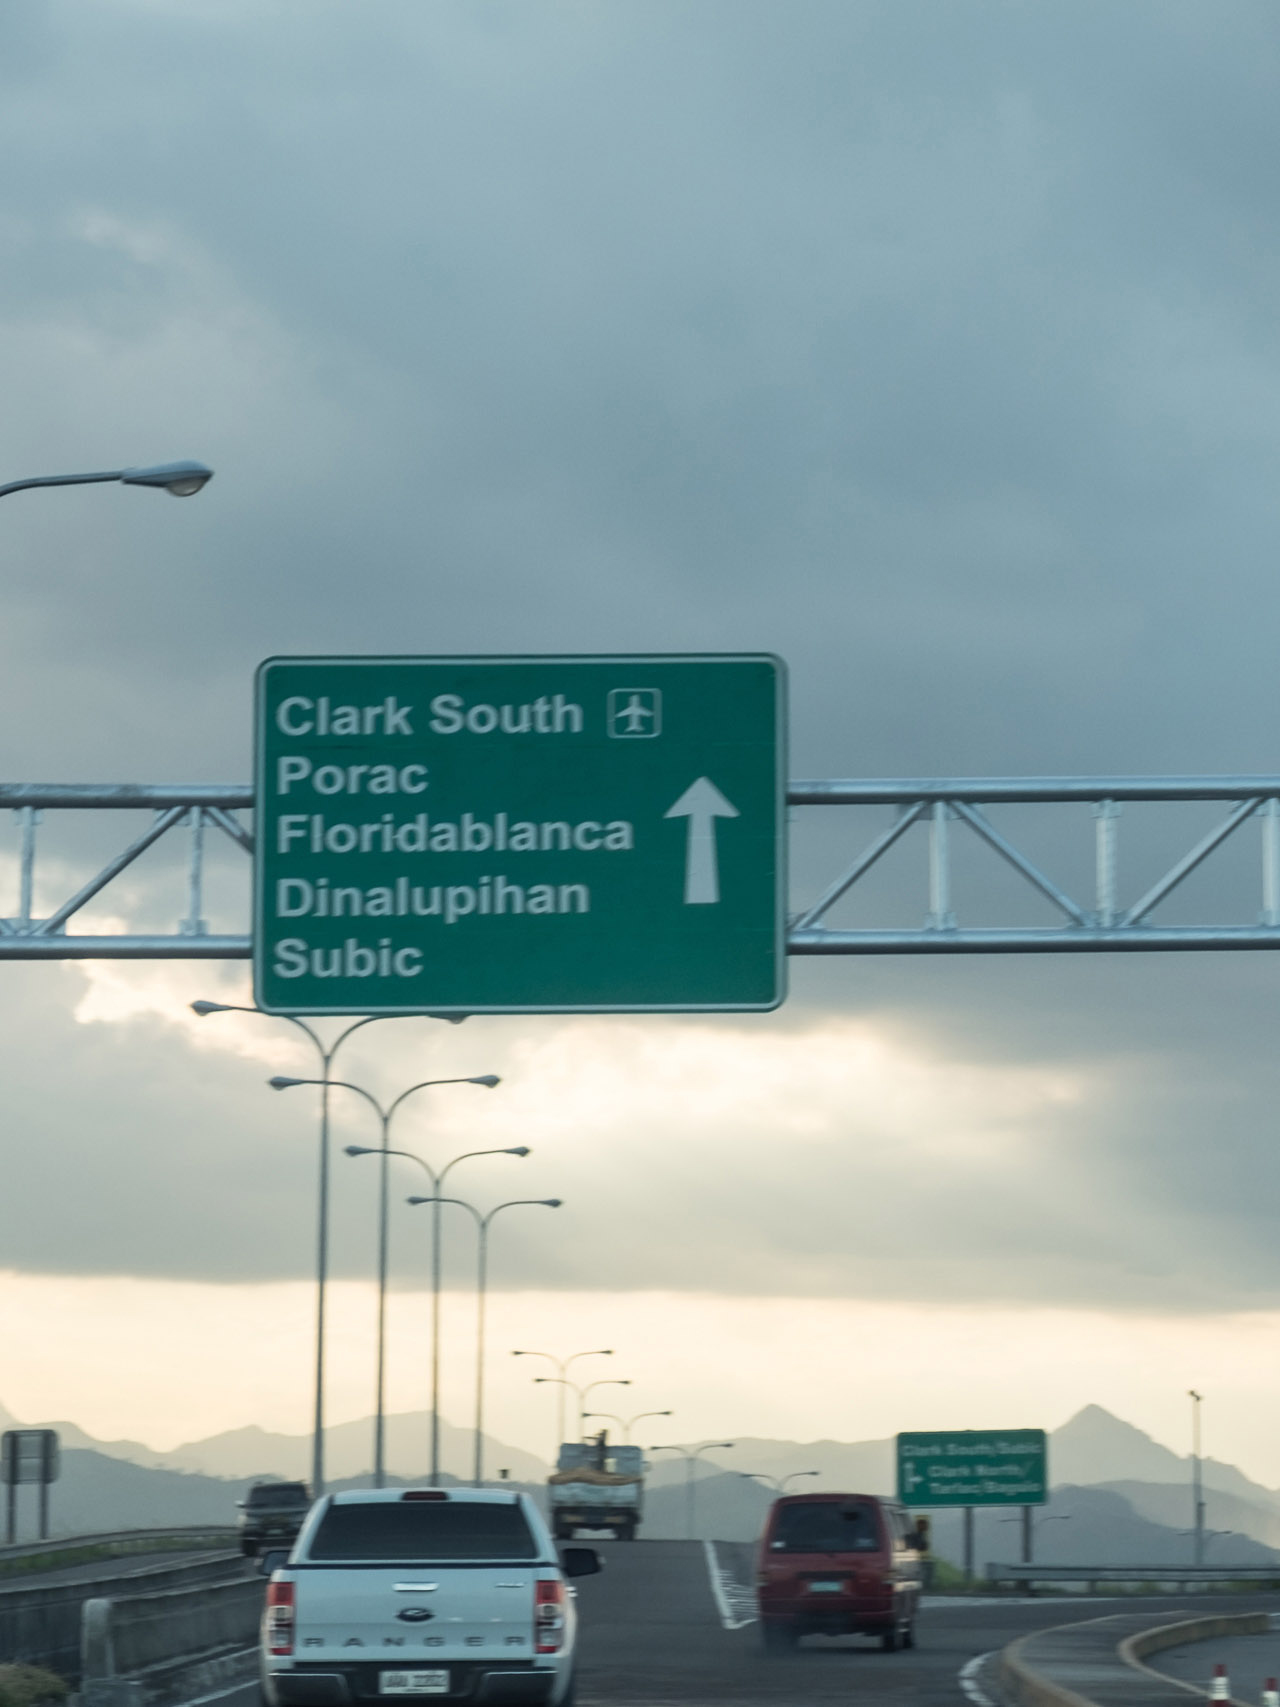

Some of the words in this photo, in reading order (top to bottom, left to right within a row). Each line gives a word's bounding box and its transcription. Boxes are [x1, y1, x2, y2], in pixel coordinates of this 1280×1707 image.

[275, 696, 414, 736] Clark
[428, 694, 584, 735] South
[276, 756, 429, 795] Porac
[277, 813, 634, 854] Floridablanca
[276, 875, 590, 924] Dinalupihan
[273, 938, 423, 979] Subic
[303, 1635, 525, 1648] RANGER
